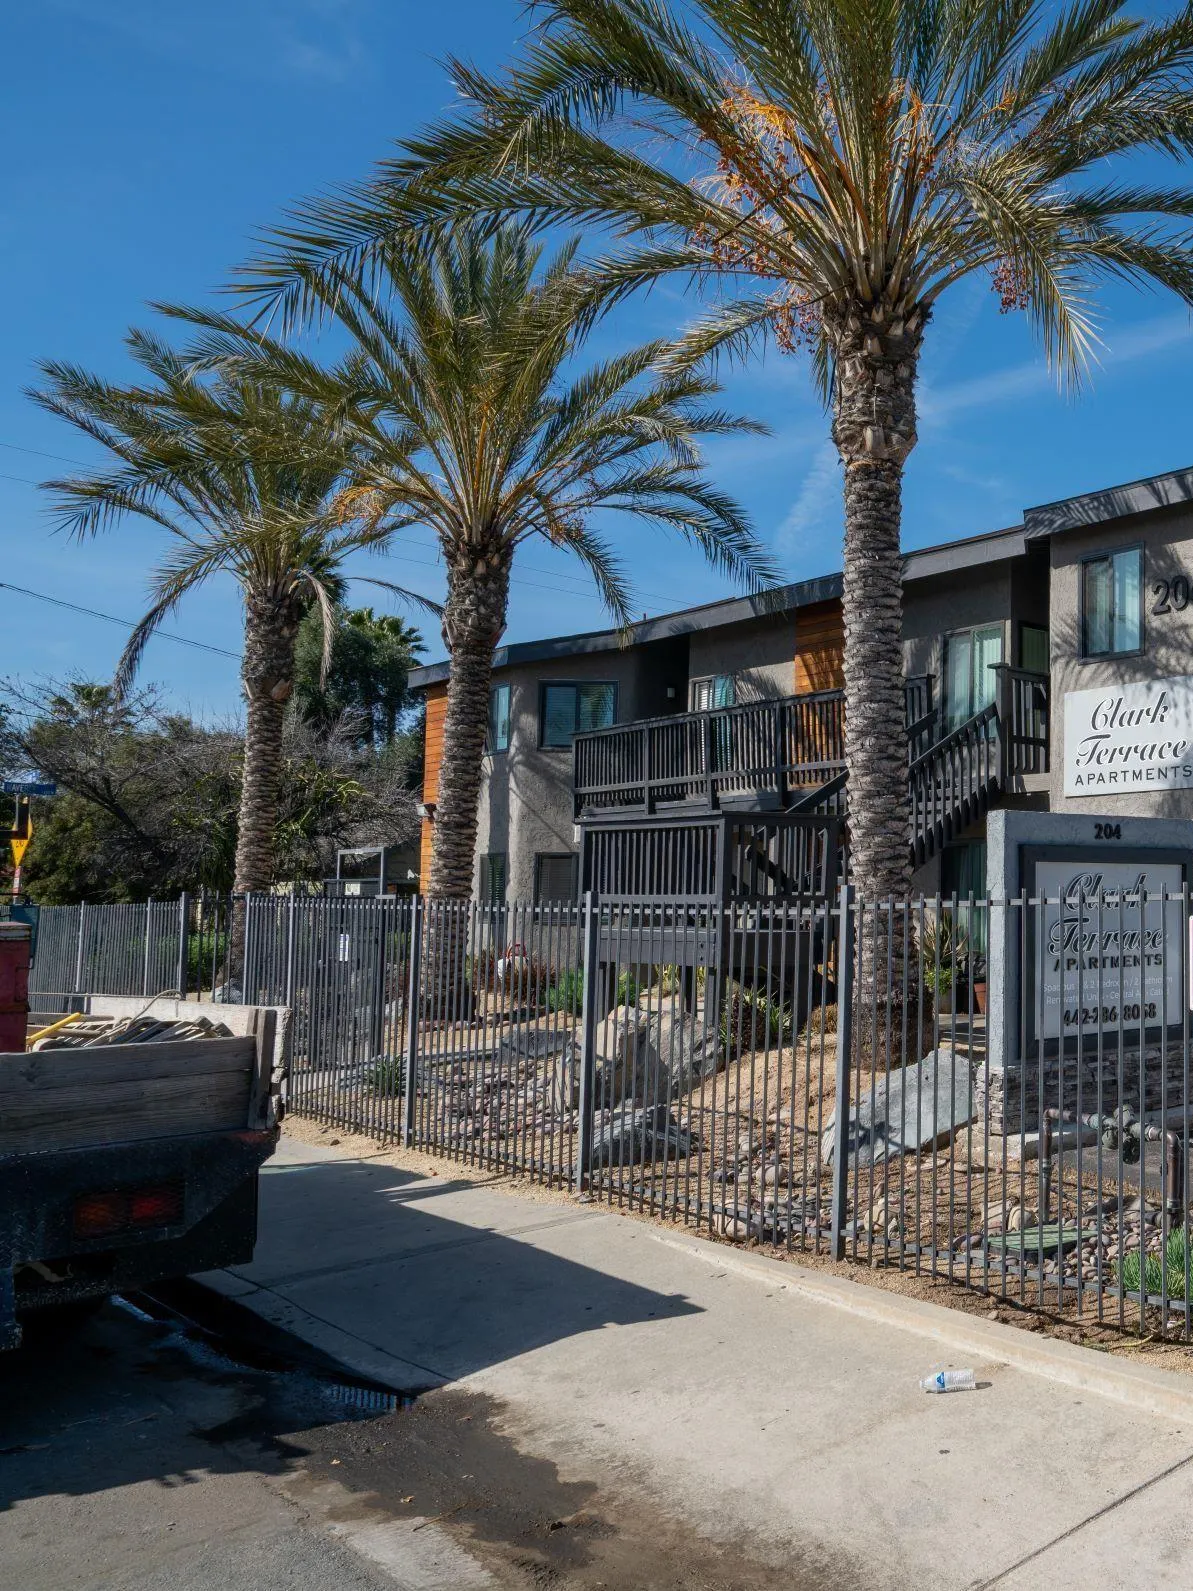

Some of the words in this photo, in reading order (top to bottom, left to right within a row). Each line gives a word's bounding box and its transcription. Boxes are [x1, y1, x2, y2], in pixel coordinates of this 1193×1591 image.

[1090, 690, 1170, 732] Clark
[1075, 733, 1190, 768] Terrace
[1074, 765, 1193, 786] APARTMENTS
[1094, 823, 1122, 840] 204
[1042, 983, 1075, 992] Spacous
